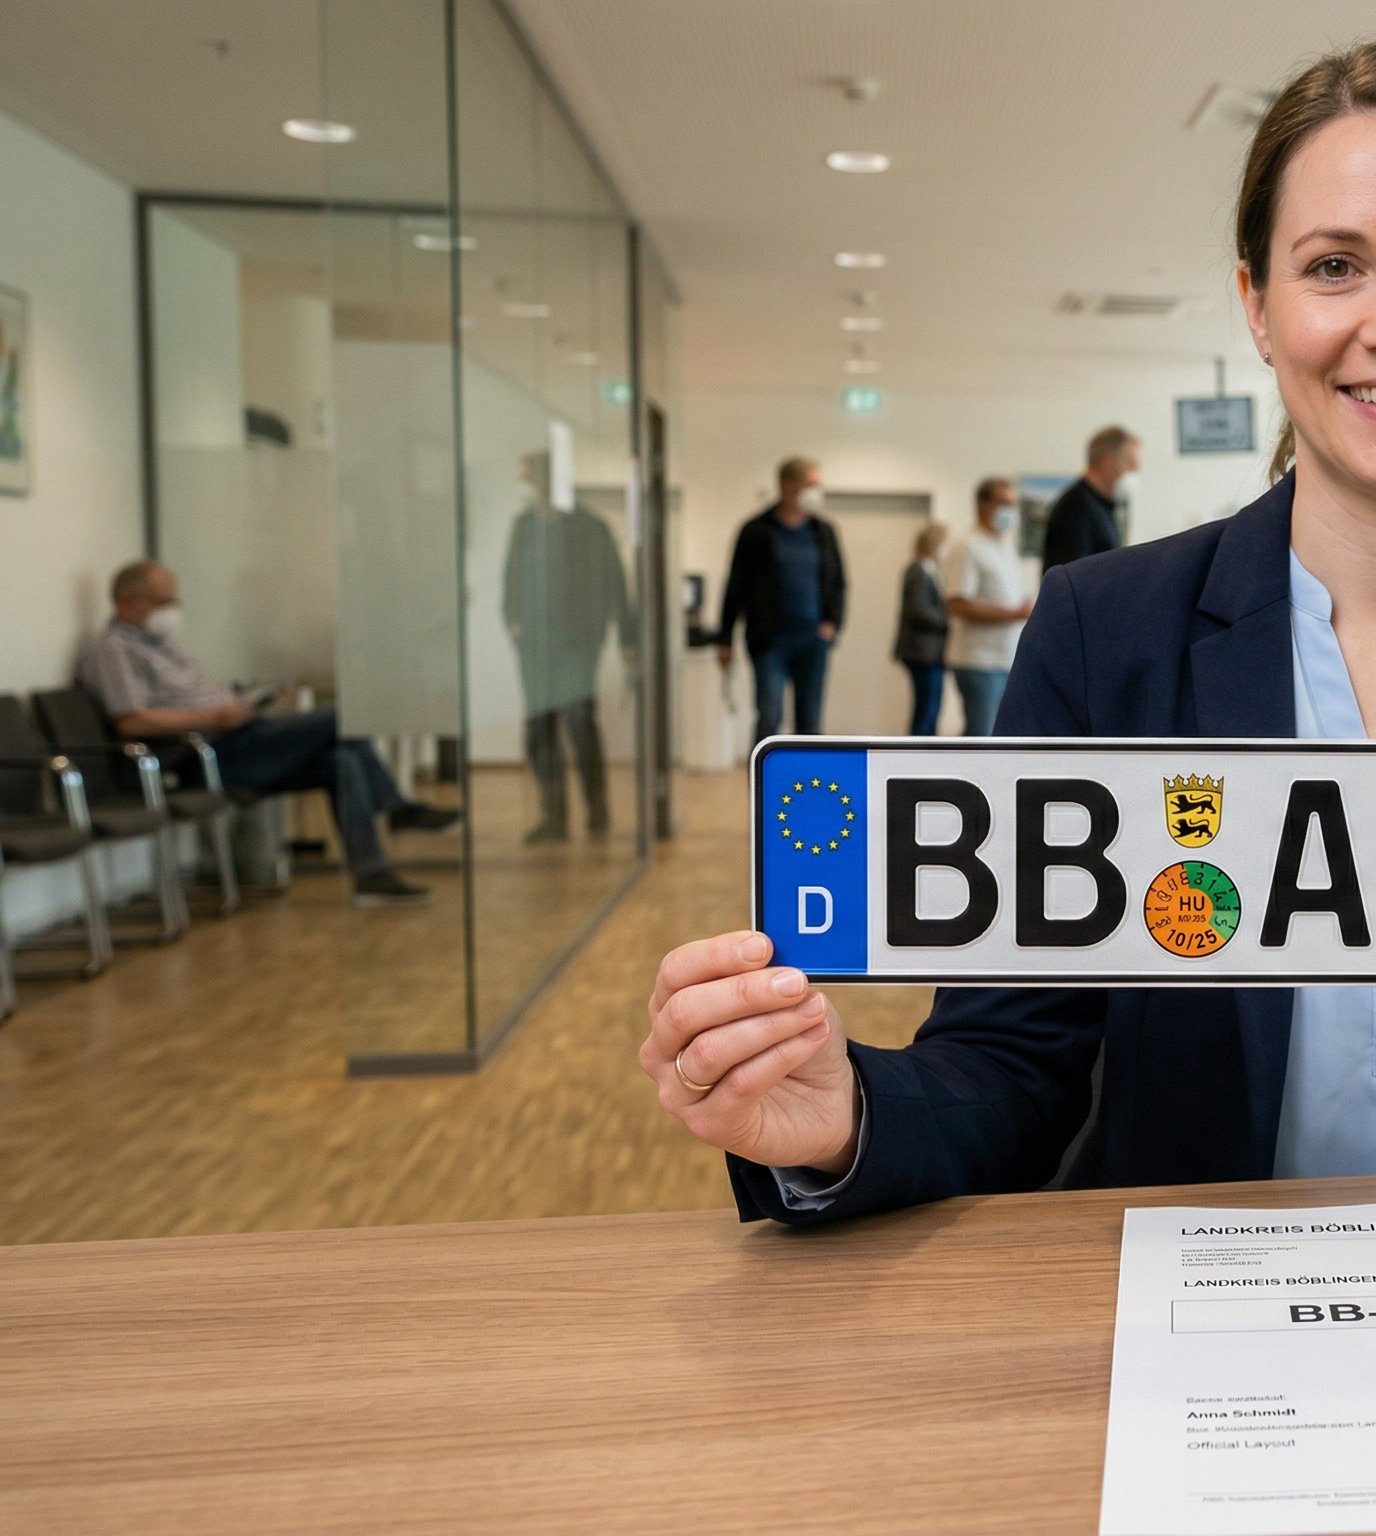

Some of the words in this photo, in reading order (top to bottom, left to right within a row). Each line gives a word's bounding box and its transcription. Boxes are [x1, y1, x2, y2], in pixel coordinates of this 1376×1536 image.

[887, 779, 1126, 947] BB
[799, 887, 832, 933] D
[1180, 896, 1205, 911] HU
[1167, 929, 1217, 950] 10/25
[1181, 1225, 1303, 1236] LANDKREIS
[1184, 1278, 1281, 1288] LANDKREIS
[1187, 1411, 1228, 1419] Anna
[1233, 1408, 1296, 1418] Schmidt
[1187, 1440, 1240, 1450] Official
[1244, 1439, 1296, 1450] Layout
